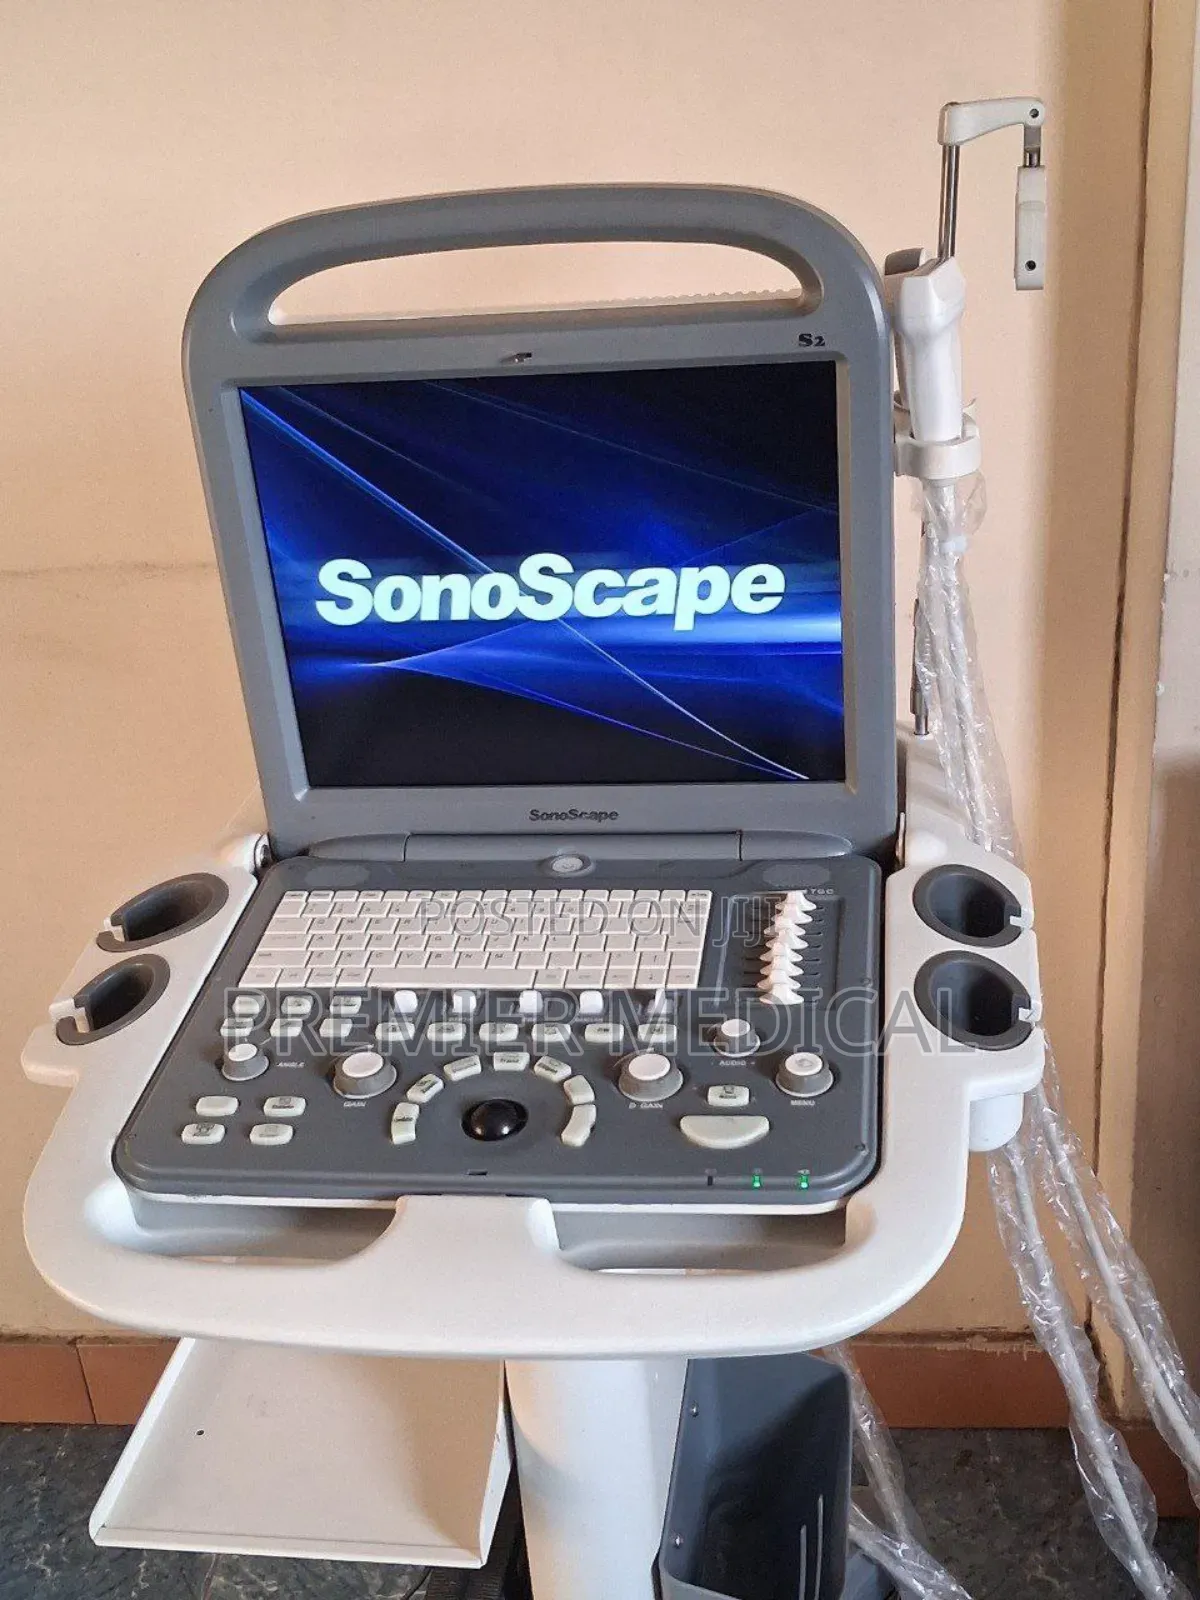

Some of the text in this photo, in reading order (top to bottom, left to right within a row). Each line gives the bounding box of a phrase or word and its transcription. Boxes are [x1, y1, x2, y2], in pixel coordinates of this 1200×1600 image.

[798, 333, 826, 347] S2
[315, 552, 786, 631] SonoScape
[528, 808, 619, 823] SonoScape
